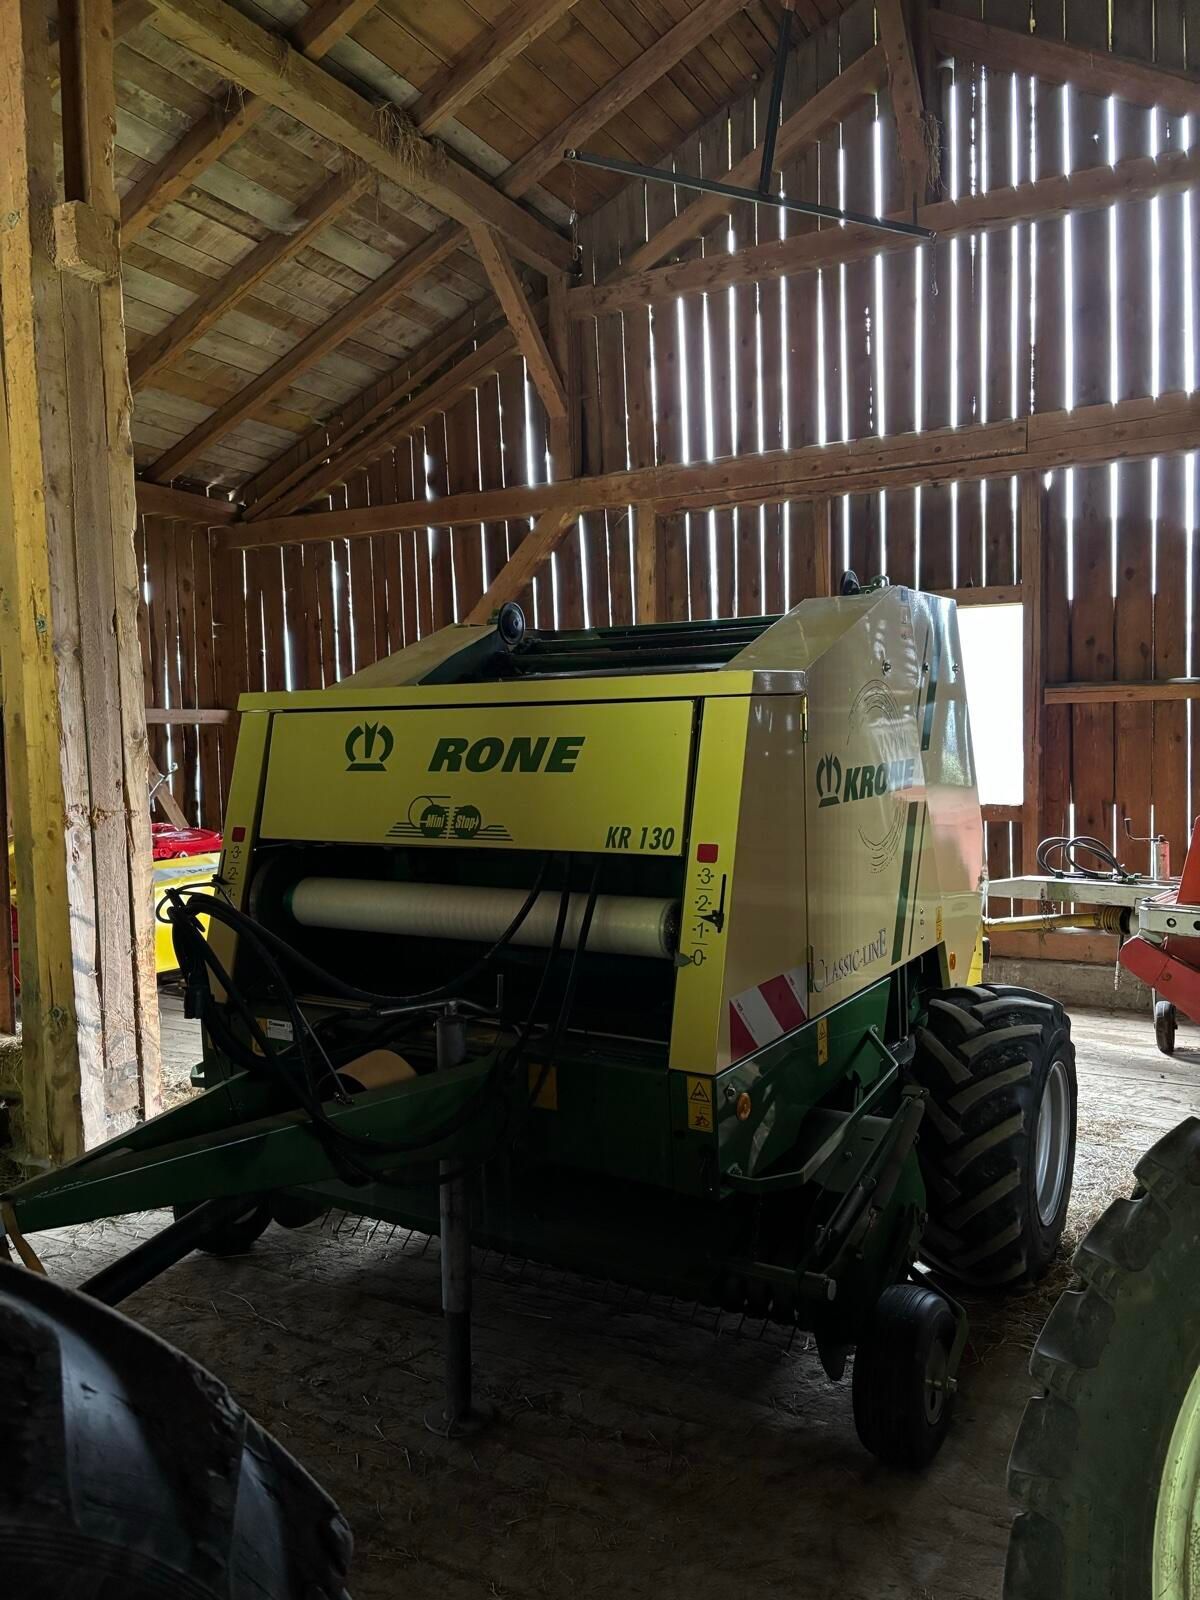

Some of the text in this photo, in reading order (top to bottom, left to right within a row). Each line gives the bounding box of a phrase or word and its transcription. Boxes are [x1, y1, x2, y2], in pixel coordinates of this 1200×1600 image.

[427, 736, 586, 773] RONE
[843, 758, 915, 803] KRONE
[426, 814, 477, 831] Mini Stop
[605, 826, 675, 850] KR 130
